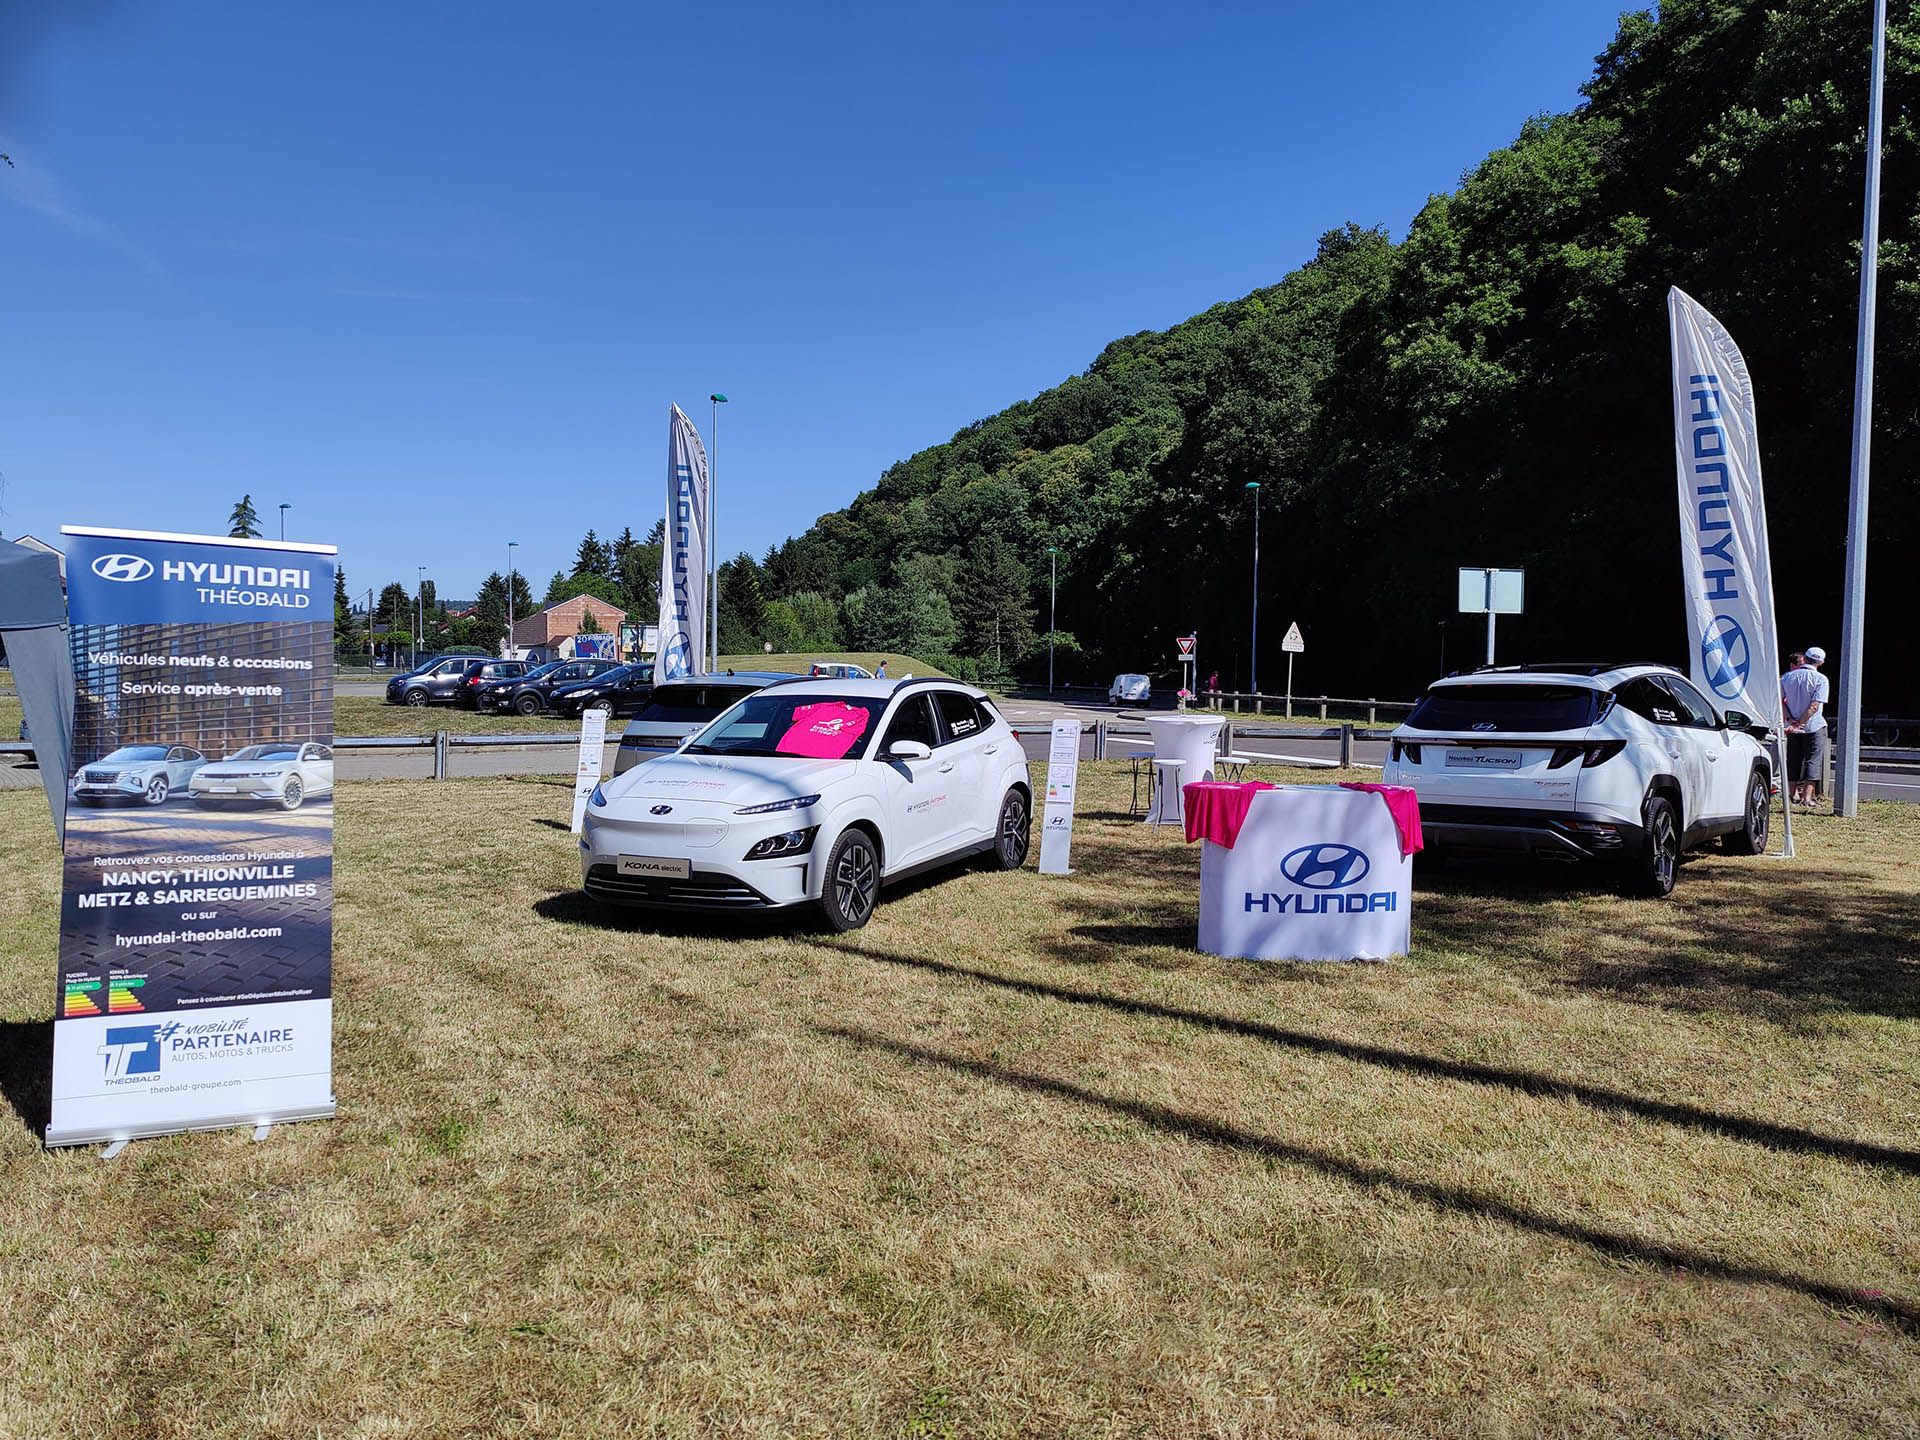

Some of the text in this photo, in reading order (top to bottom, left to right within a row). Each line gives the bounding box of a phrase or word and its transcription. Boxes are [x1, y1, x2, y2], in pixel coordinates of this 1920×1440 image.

[1689, 374, 1738, 600] HYUNDAI
[672, 465, 692, 622] HYUNDAI
[163, 560, 310, 590] HYUNDAI
[196, 587, 310, 609] THÉOBALD
[88, 652, 313, 671] Véhicules neufs & occasions
[121, 682, 283, 697] Service après-vente
[94, 855, 151, 867] Retrouvez
[152, 856, 173, 865] vos
[175, 852, 245, 863] concessions
[248, 850, 296, 862] Hyundai
[624, 861, 682, 873] KONA electric
[103, 865, 295, 887] NANCY, THIONVILLE
[78, 884, 317, 908] METZ & SARREGUEMINES
[1244, 891, 1397, 914] HYUNDAI
[181, 910, 218, 921] ou sur
[116, 926, 283, 949] hyundai-theobald.com
[172, 1028, 294, 1051] PARTENAIRE
[171, 1043, 294, 1063] AUTOS, MOTOS & TRUCKS
[104, 1074, 161, 1087] THEOBALD
[150, 1079, 242, 1095] theobald-groupe.com
